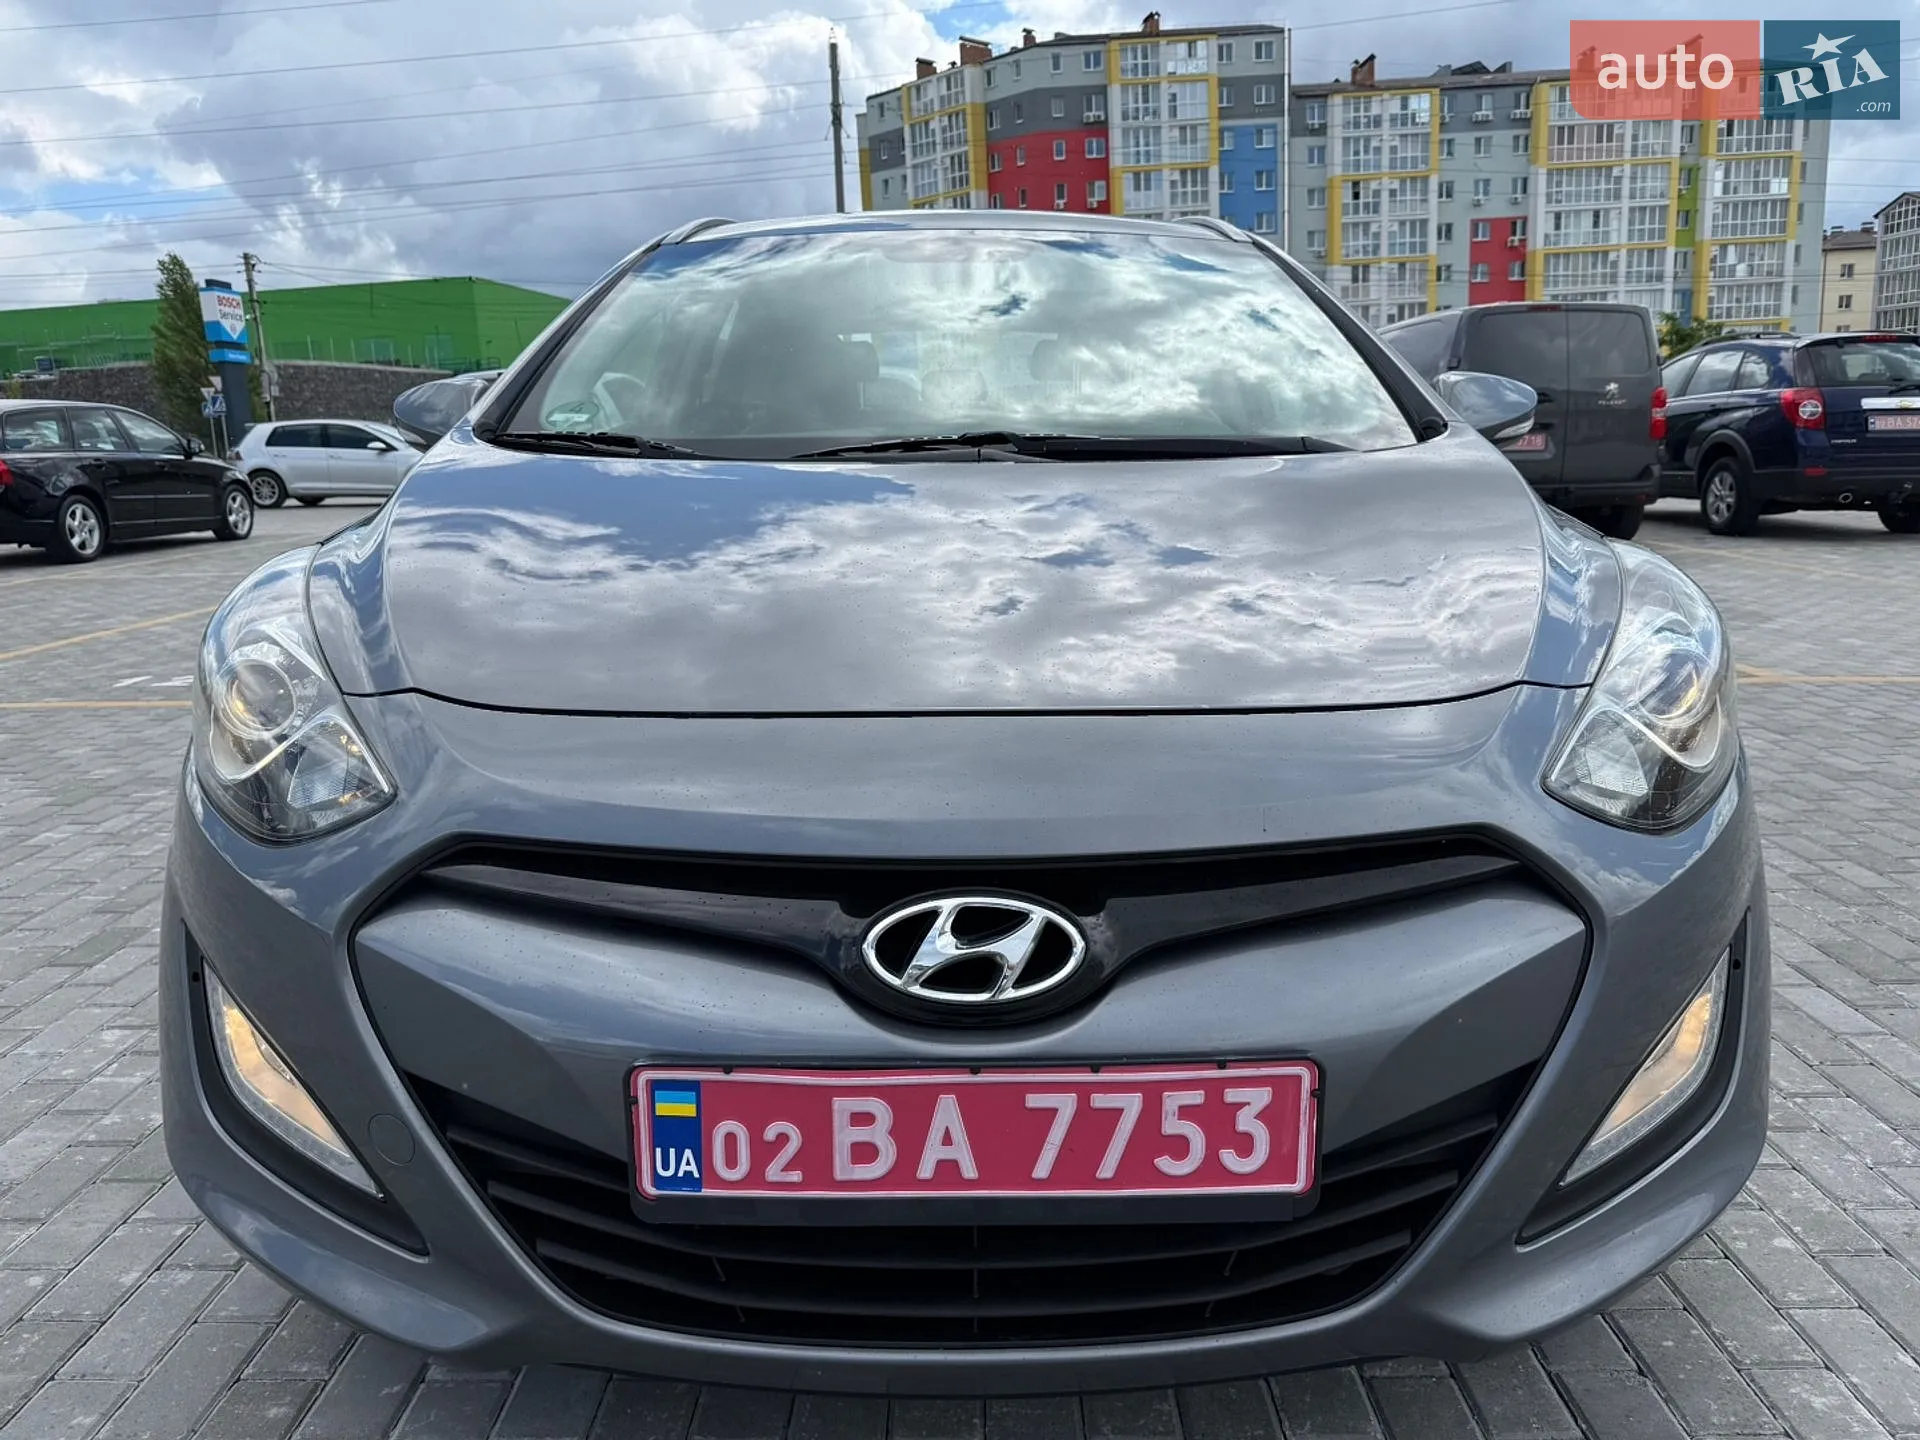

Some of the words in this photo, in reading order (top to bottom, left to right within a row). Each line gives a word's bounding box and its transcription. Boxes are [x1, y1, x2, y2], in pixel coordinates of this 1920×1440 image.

[216, 295, 241, 309] BOSCH
[219, 309, 244, 322] Service
[711, 1119, 803, 1183] 02
[832, 1094, 979, 1181] BA
[1025, 1087, 1273, 1181] 7753
[654, 1147, 700, 1179] UA
